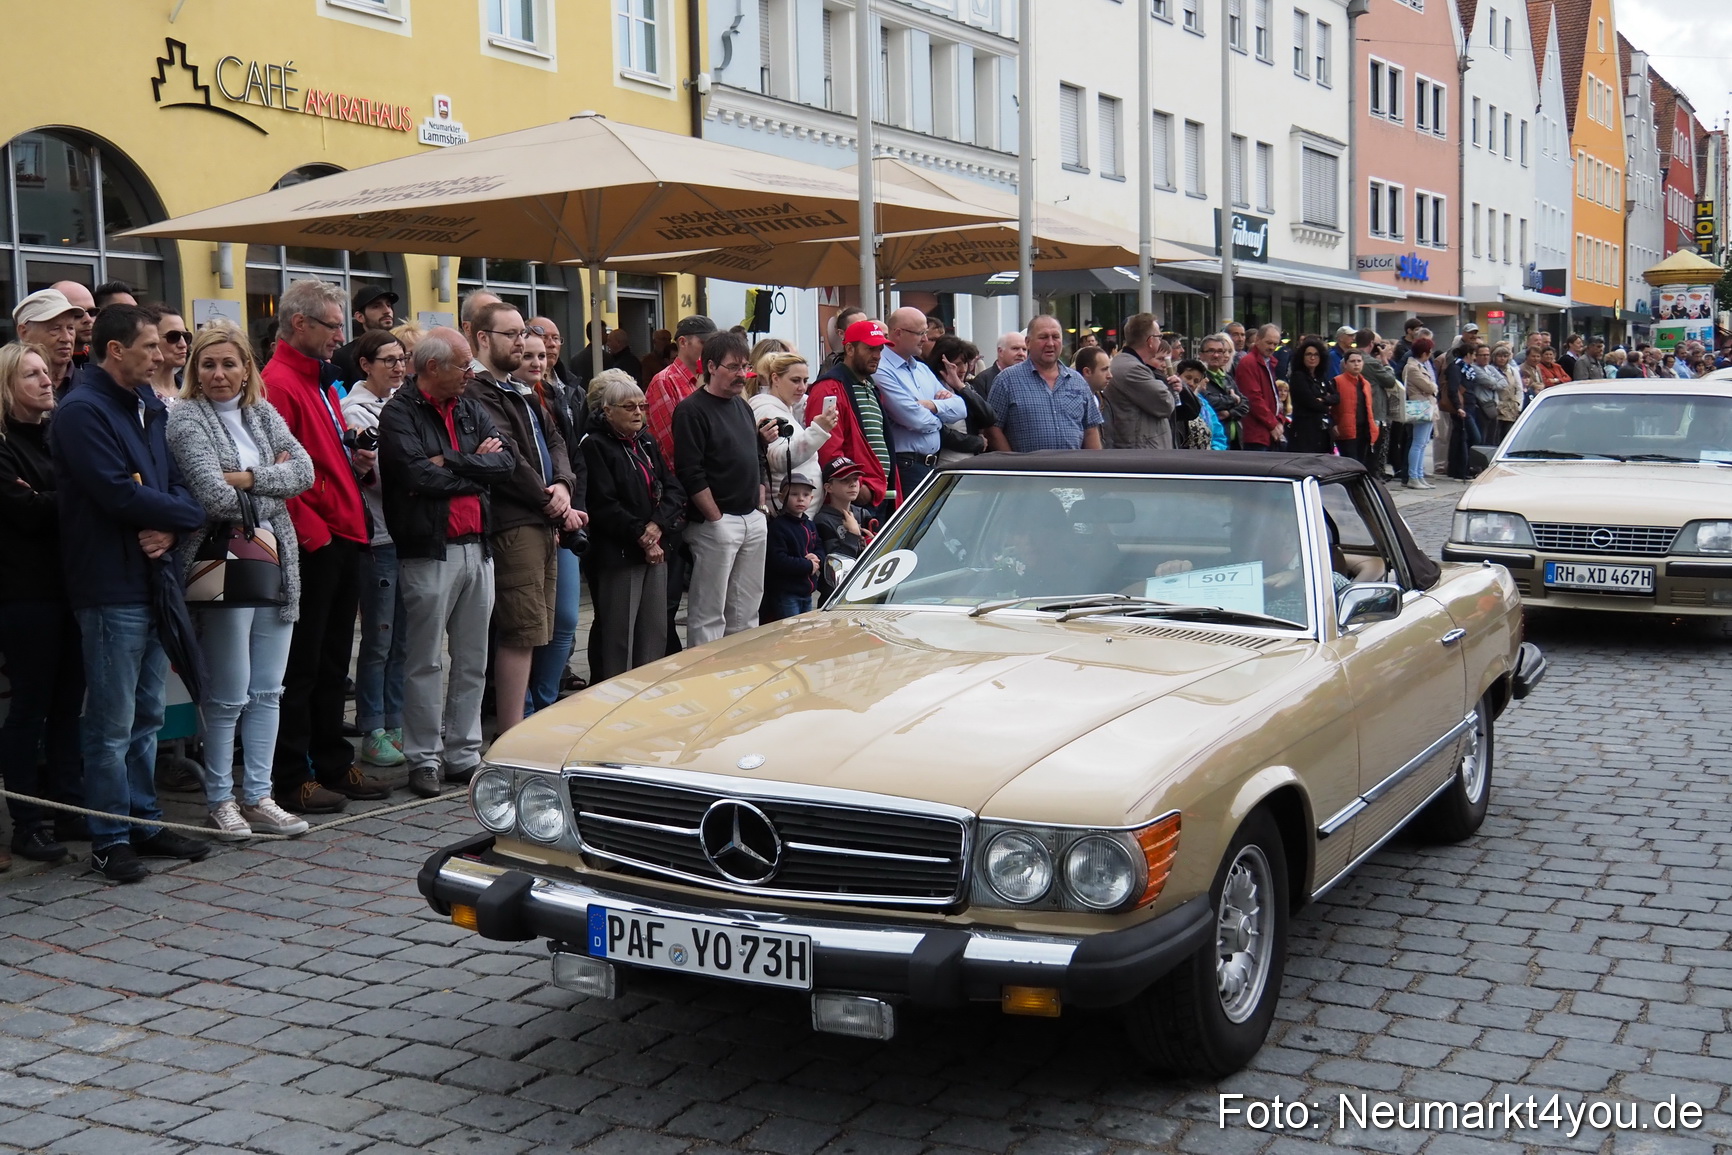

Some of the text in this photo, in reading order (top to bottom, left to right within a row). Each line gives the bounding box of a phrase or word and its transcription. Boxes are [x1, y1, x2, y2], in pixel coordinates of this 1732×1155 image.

[216, 55, 299, 111] CAFÉ
[337, 93, 413, 132] RATHAUS
[428, 121, 461, 134] Neumarkter
[422, 130, 467, 146] Lammsbräu
[681, 293, 692, 308] 24
[861, 557, 900, 590] 19
[1202, 571, 1239, 583] 507
[1555, 565, 1575, 582] RH
[1587, 567, 1606, 584] XD
[1611, 568, 1651, 586] 467H
[594, 936, 602, 947] D
[607, 914, 665, 959] PAF
[692, 927, 732, 970] YO
[741, 934, 806, 981] 73H
